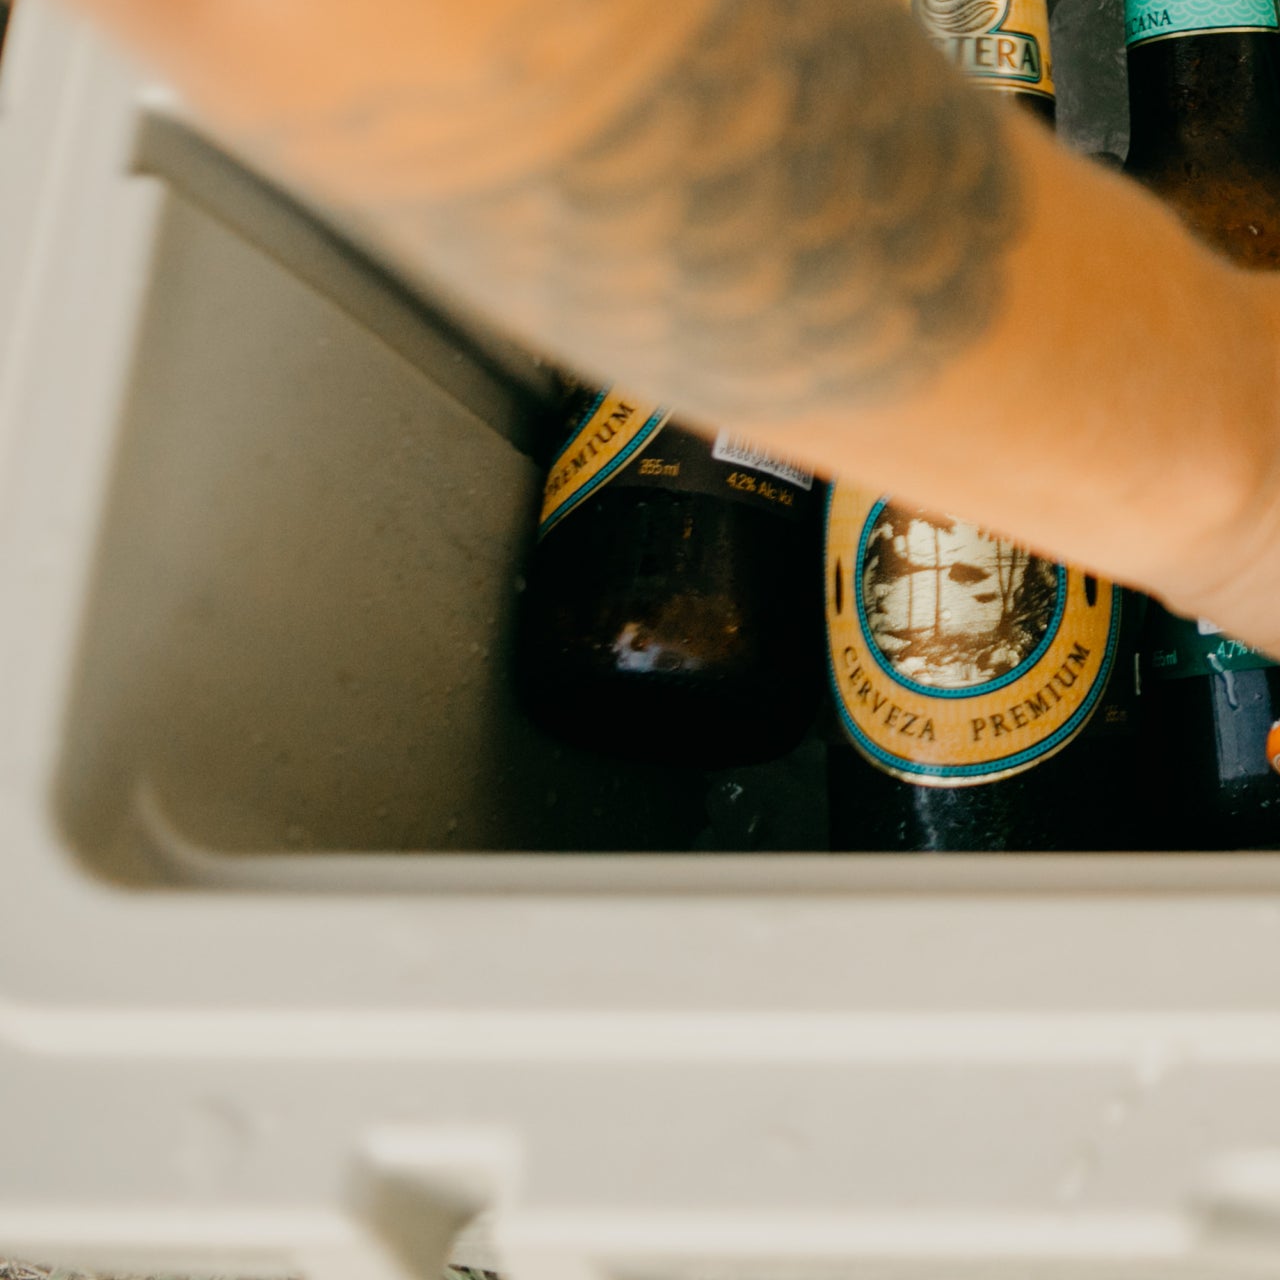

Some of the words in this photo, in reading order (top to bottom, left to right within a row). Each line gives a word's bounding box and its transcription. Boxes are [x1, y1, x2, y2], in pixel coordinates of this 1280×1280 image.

[1131, 8, 1173, 36] CANA
[843, 645, 937, 741] CERVEZA
[971, 640, 1092, 741] PREMIUM
